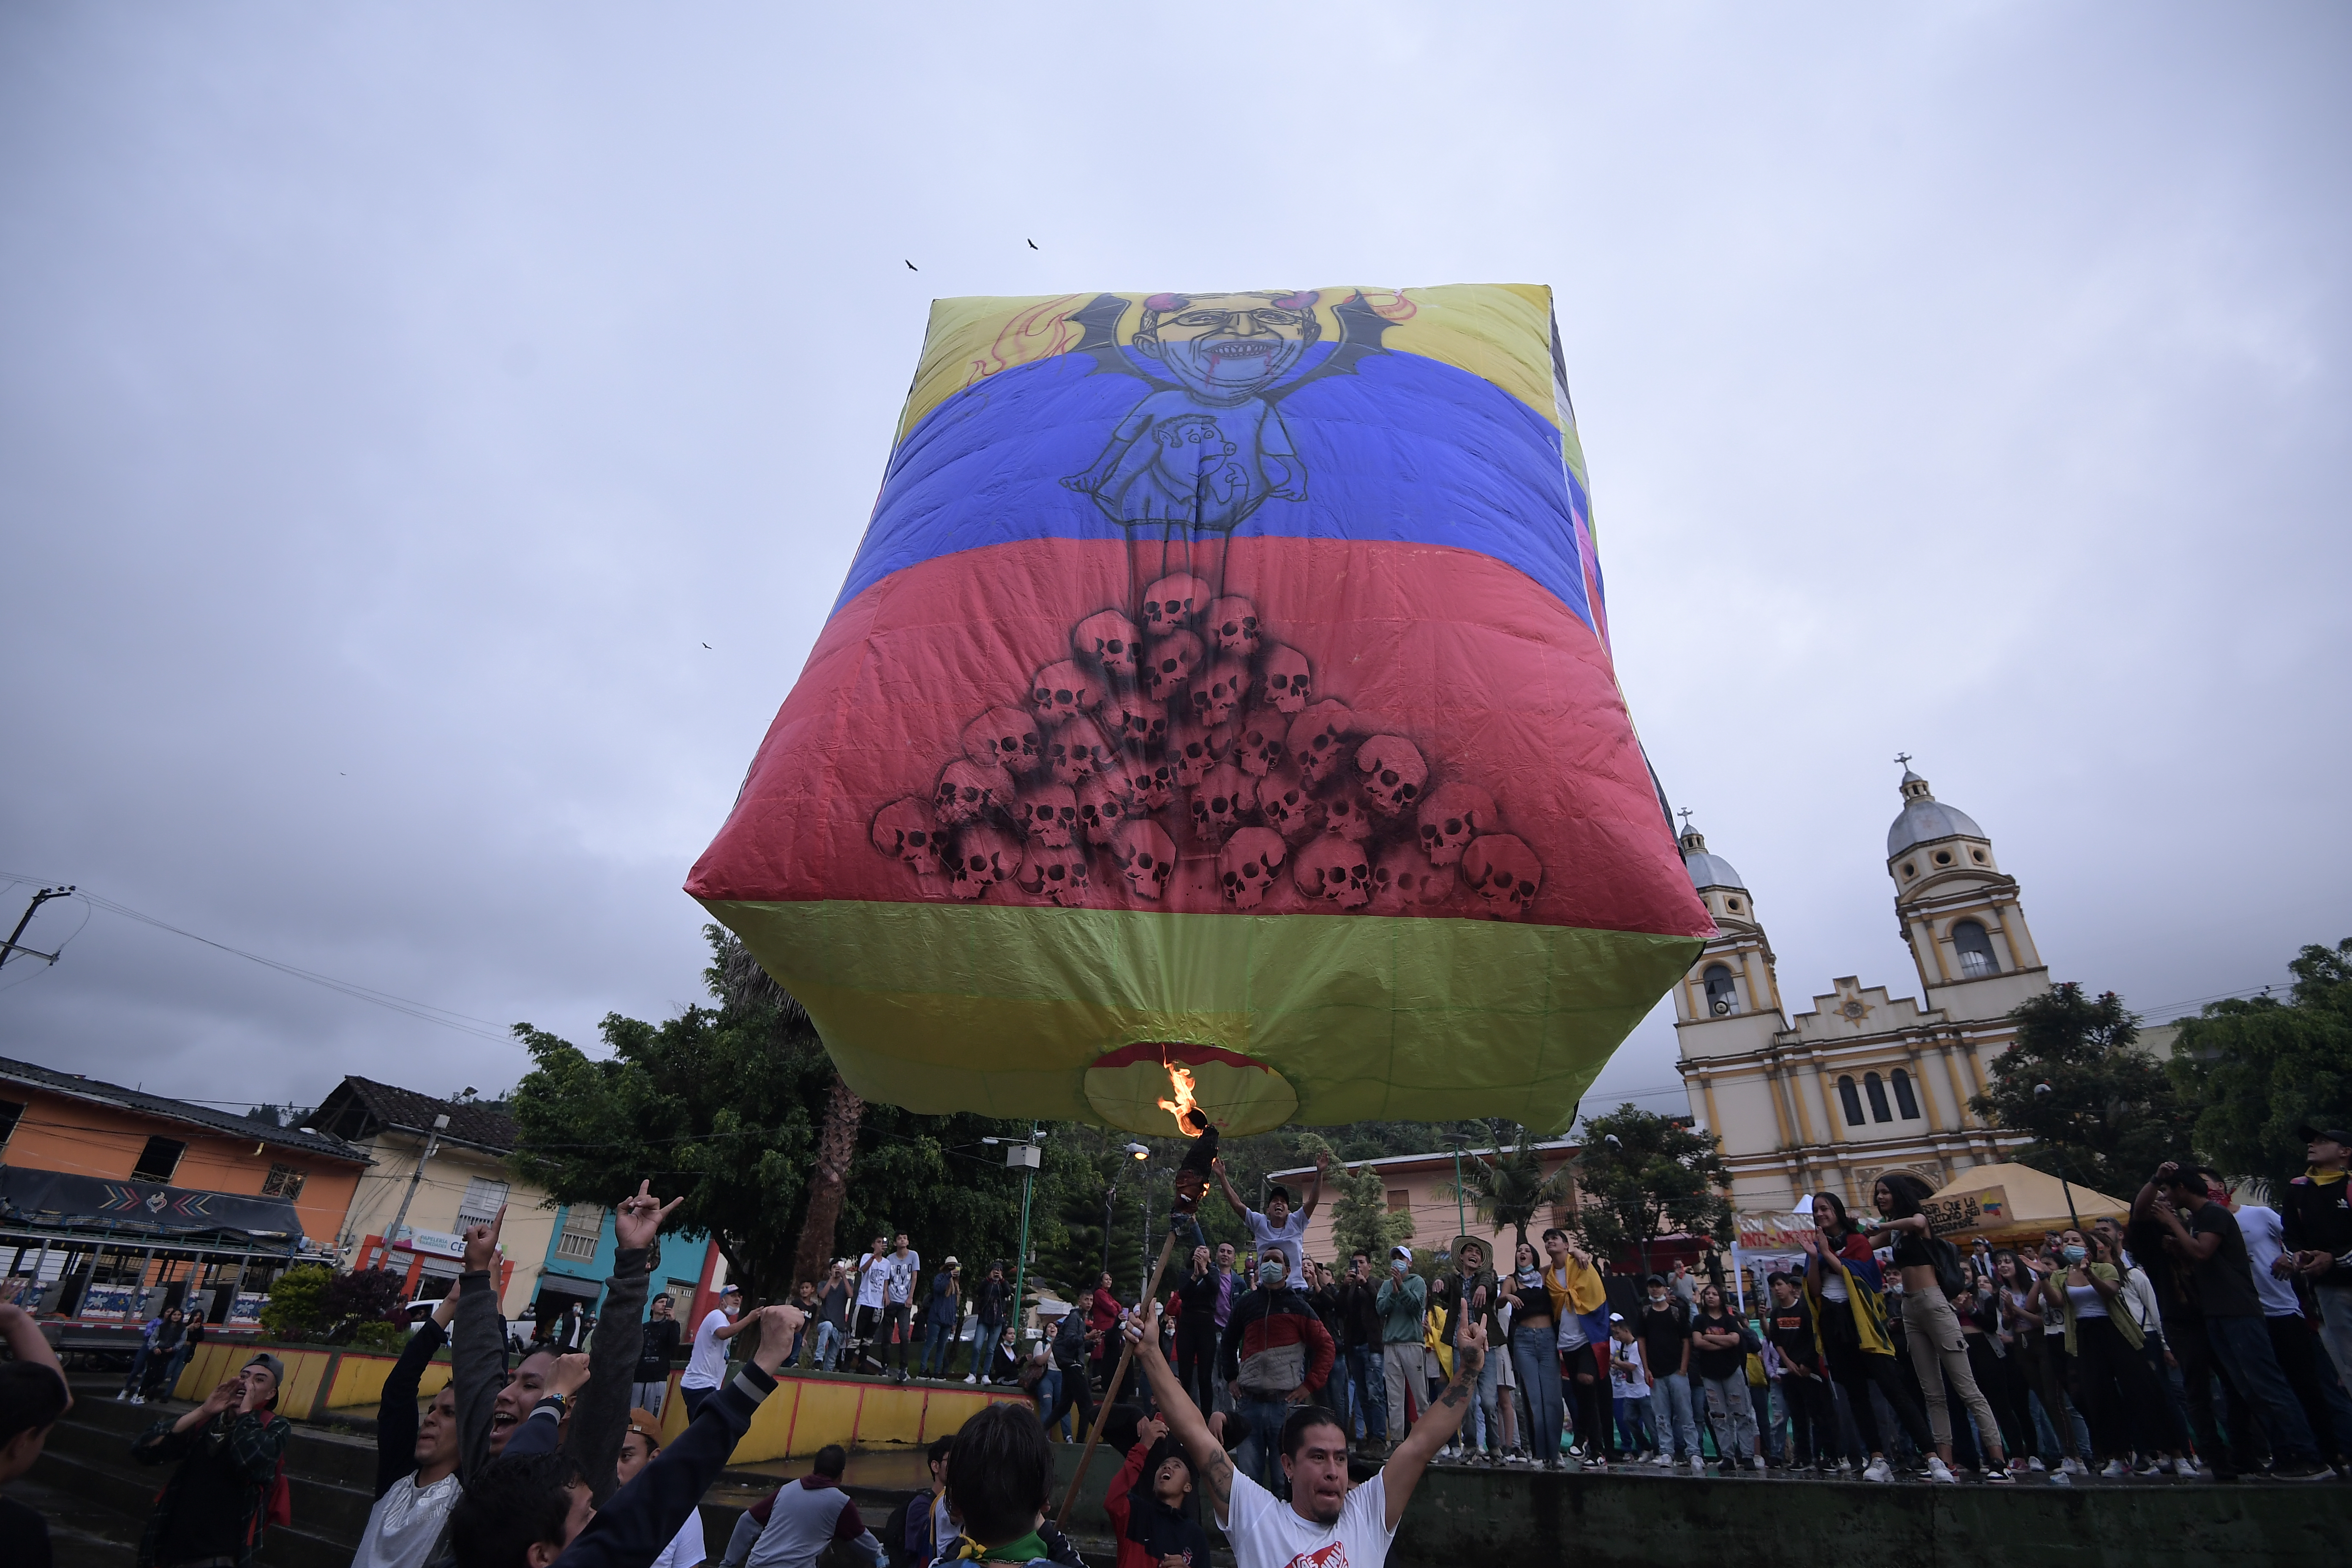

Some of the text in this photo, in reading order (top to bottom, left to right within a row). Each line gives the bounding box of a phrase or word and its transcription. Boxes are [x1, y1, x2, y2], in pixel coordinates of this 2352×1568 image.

[1943, 1200, 1961, 1212] QUE
[1964, 1197, 1975, 1208] LA
[450, 1241, 466, 1252] CE
